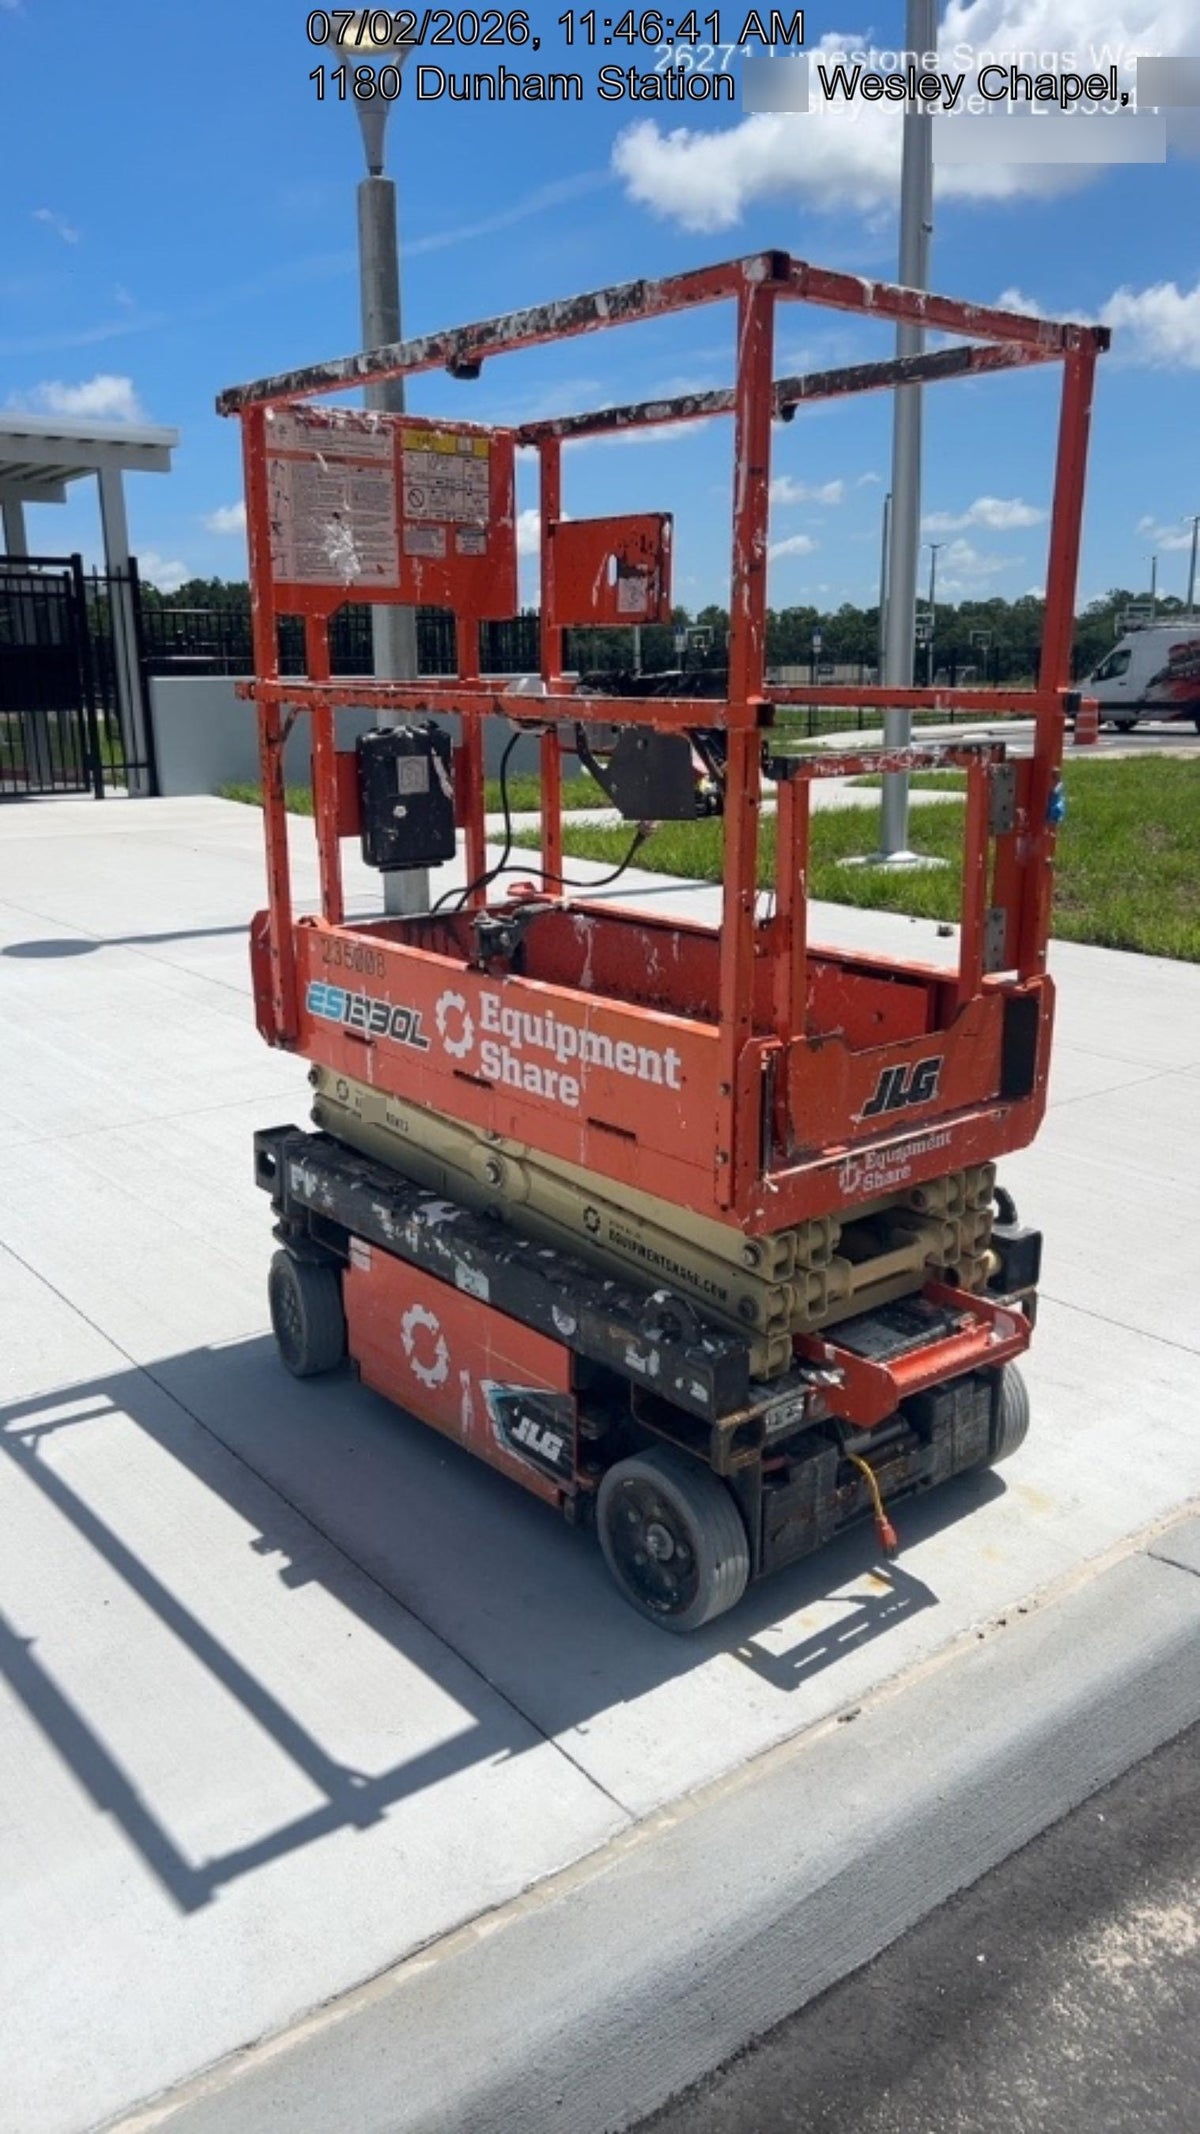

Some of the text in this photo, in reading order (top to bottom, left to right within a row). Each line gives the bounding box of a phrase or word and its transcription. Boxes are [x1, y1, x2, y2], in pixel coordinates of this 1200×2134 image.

[479, 990, 682, 1091] Equipment
[480, 1039, 581, 1108] Share
[860, 1055, 944, 1121] JLG
[861, 1164, 912, 1192] Share
[864, 1130, 953, 1171] Equipment
[510, 1415, 566, 1462] JLG
